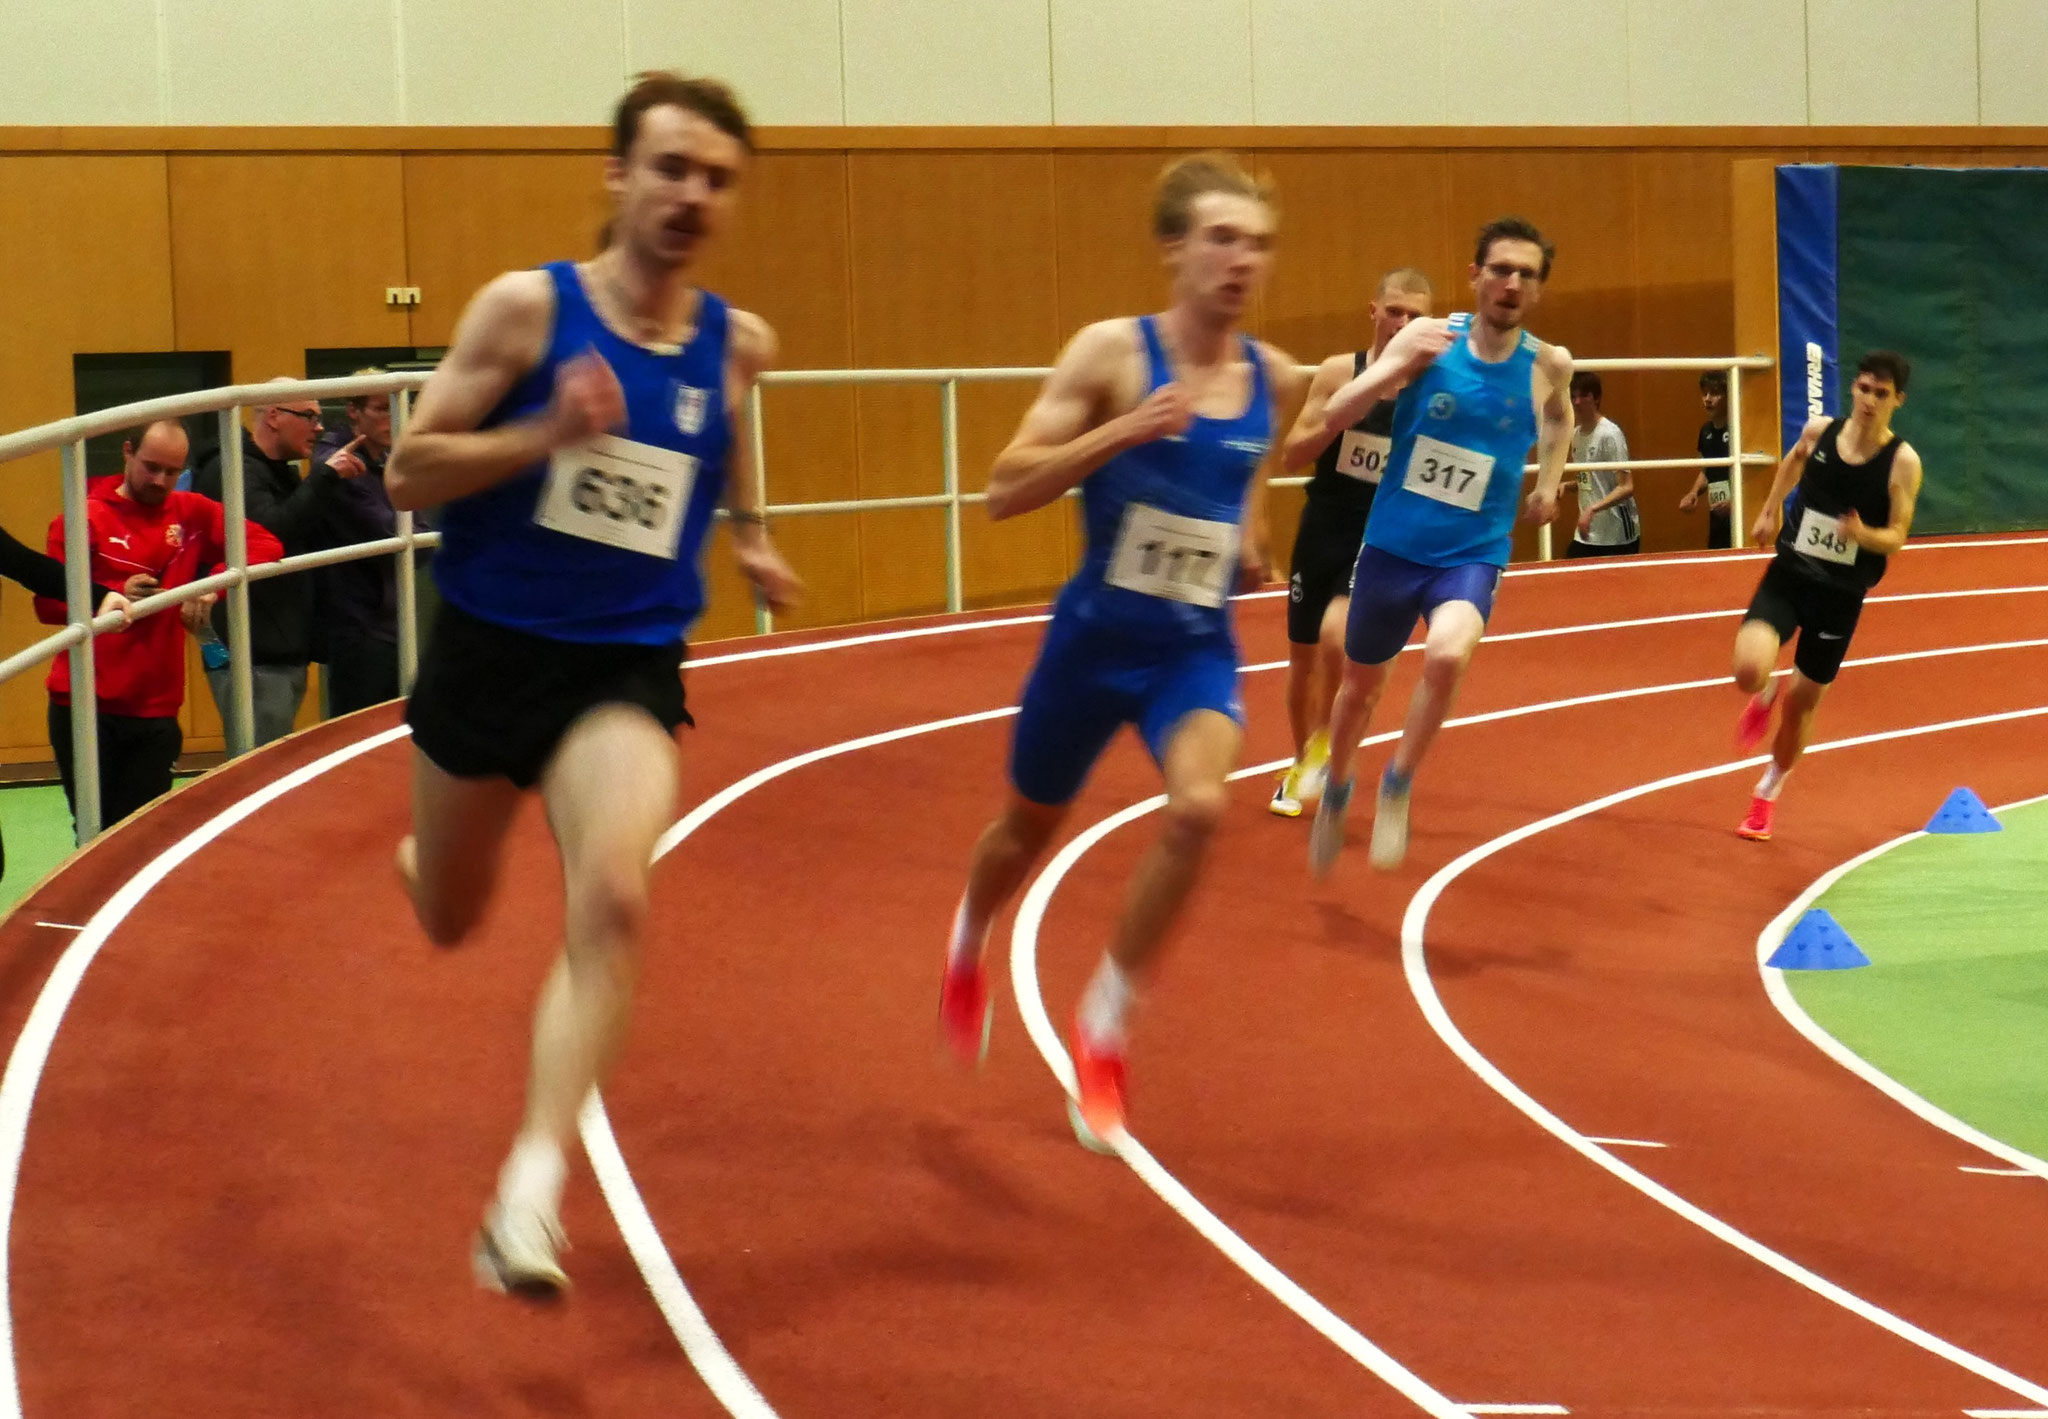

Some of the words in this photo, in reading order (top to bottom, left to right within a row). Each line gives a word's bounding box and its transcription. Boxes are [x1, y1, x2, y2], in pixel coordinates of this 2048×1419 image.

[1806, 342, 1822, 419] ERHAR
[1420, 457, 1476, 494] 317
[1138, 540, 1220, 585] 117
